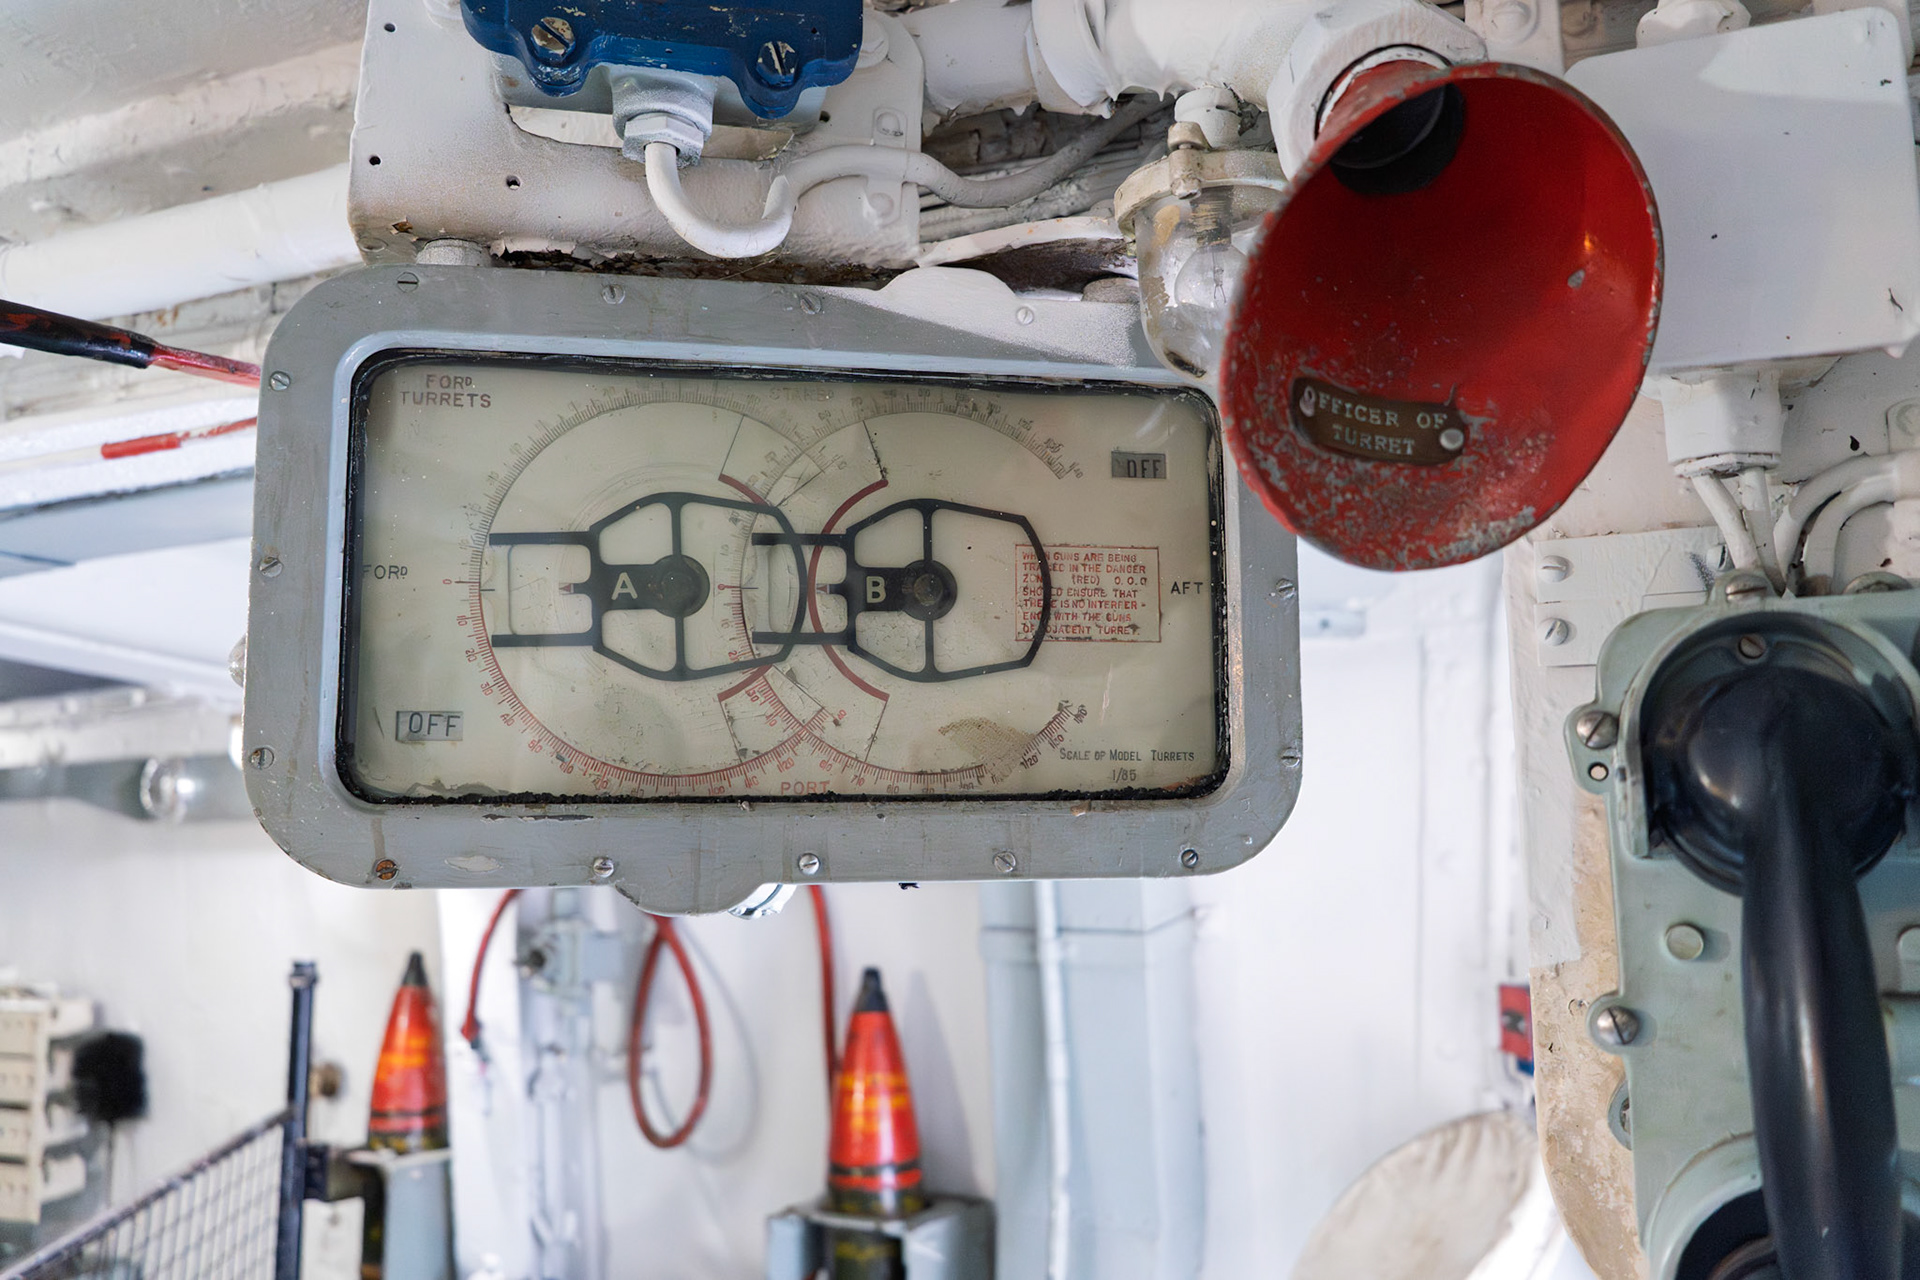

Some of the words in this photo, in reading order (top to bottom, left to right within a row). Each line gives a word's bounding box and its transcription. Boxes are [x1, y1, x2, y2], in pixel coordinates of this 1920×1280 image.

[426, 373, 473, 390] FORD
[400, 391, 491, 408] TURRETS
[1303, 385, 1400, 427] OFFICER
[1416, 411, 1448, 429] OF
[1332, 423, 1416, 456] TURRET
[1022, 551, 1050, 561] WHN
[1053, 551, 1080, 561] GUNS
[1083, 552, 1104, 562] ARE
[1108, 553, 1137, 563] BEING
[1069, 563, 1079, 573] IN
[1081, 563, 1101, 573] THE
[1105, 563, 1146, 574] DANGER
[611, 571, 638, 601] A
[1022, 574, 1046, 583] ZON
[1071, 574, 1100, 585] (RED)
[1170, 580, 1204, 595] AFT
[866, 575, 887, 603] B
[1066, 587, 1107, 598] ENSURE
[1112, 588, 1138, 598] THAT
[1022, 599, 1057, 609] THEE
[1060, 600, 1070, 609] IS
[1071, 600, 1086, 609] NO
[1054, 612, 1078, 621] WITH
[1082, 612, 1101, 621] THE
[1105, 612, 1132, 623] GUNS
[408, 711, 461, 737] OFF
[1059, 748, 1091, 761] SCALE
[1109, 749, 1142, 762] MODEL
[1151, 749, 1195, 762] TURRETS
[780, 779, 831, 796] PORT
